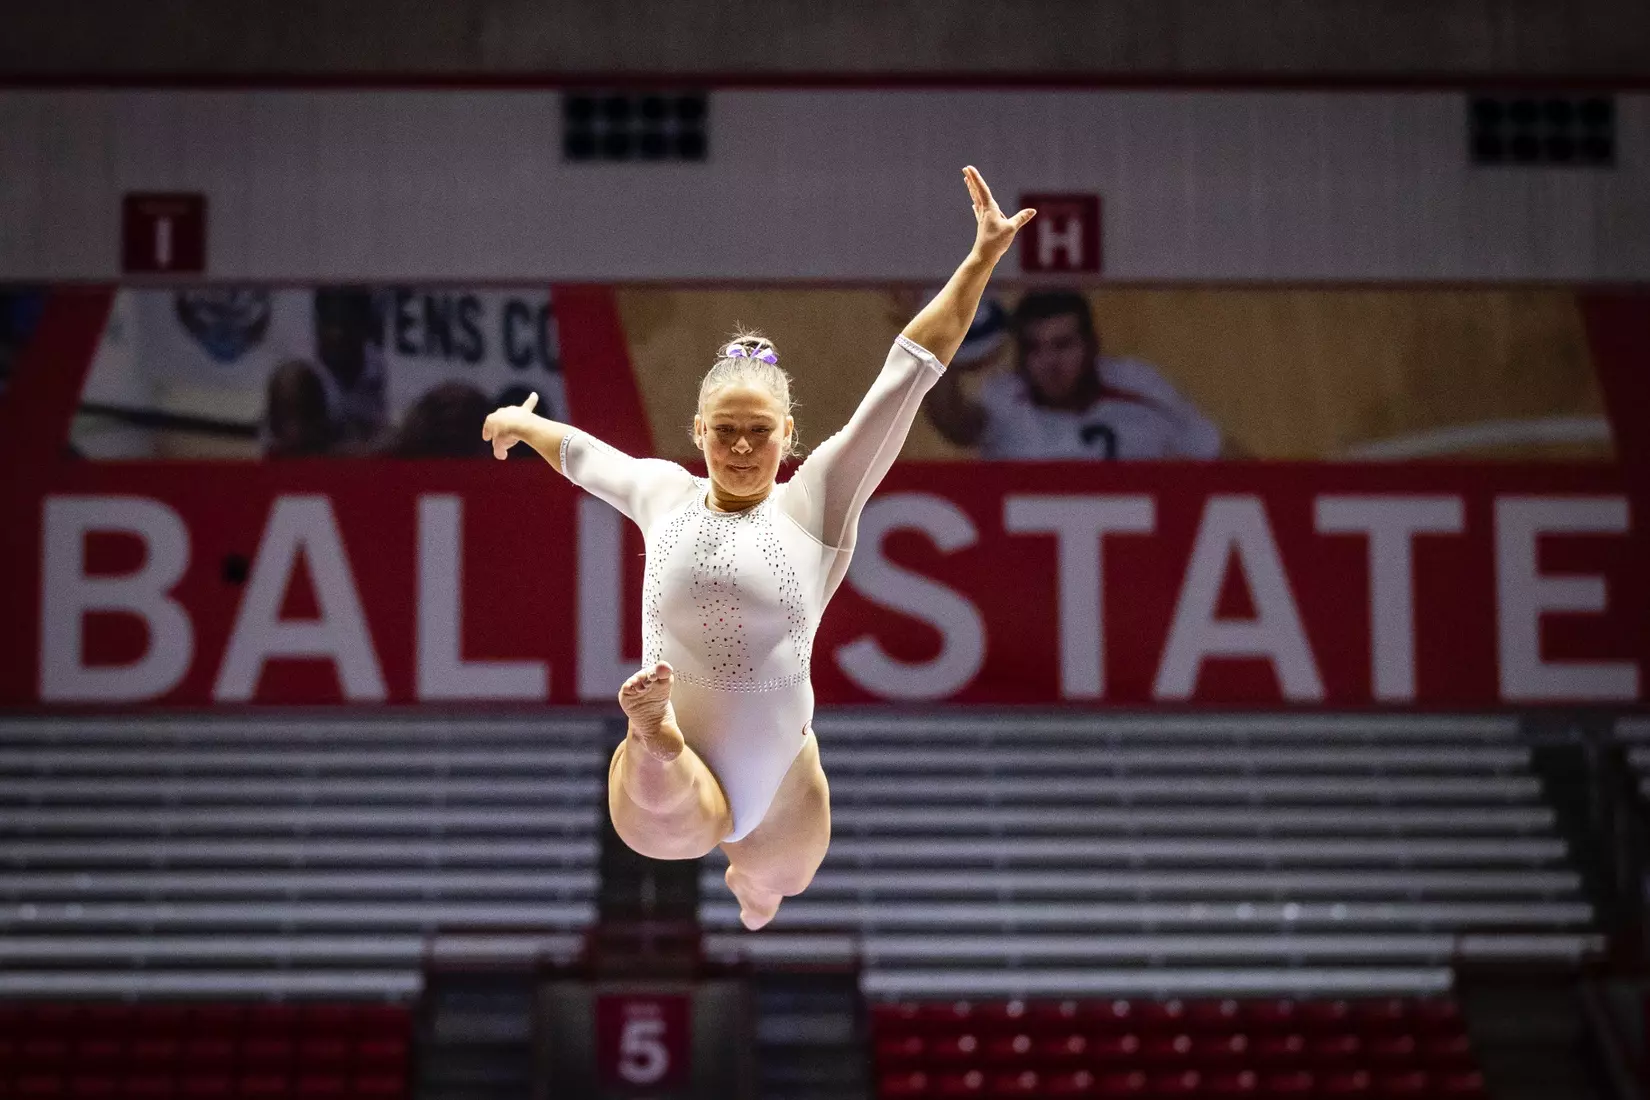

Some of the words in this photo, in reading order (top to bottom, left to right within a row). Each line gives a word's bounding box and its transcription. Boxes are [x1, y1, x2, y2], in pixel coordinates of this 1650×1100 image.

[1038, 217, 1082, 267] H
[371, 287, 484, 363] ENS
[39, 493, 645, 701] BALL
[833, 492, 1640, 702] STATE
[617, 1019, 669, 1084] 5
